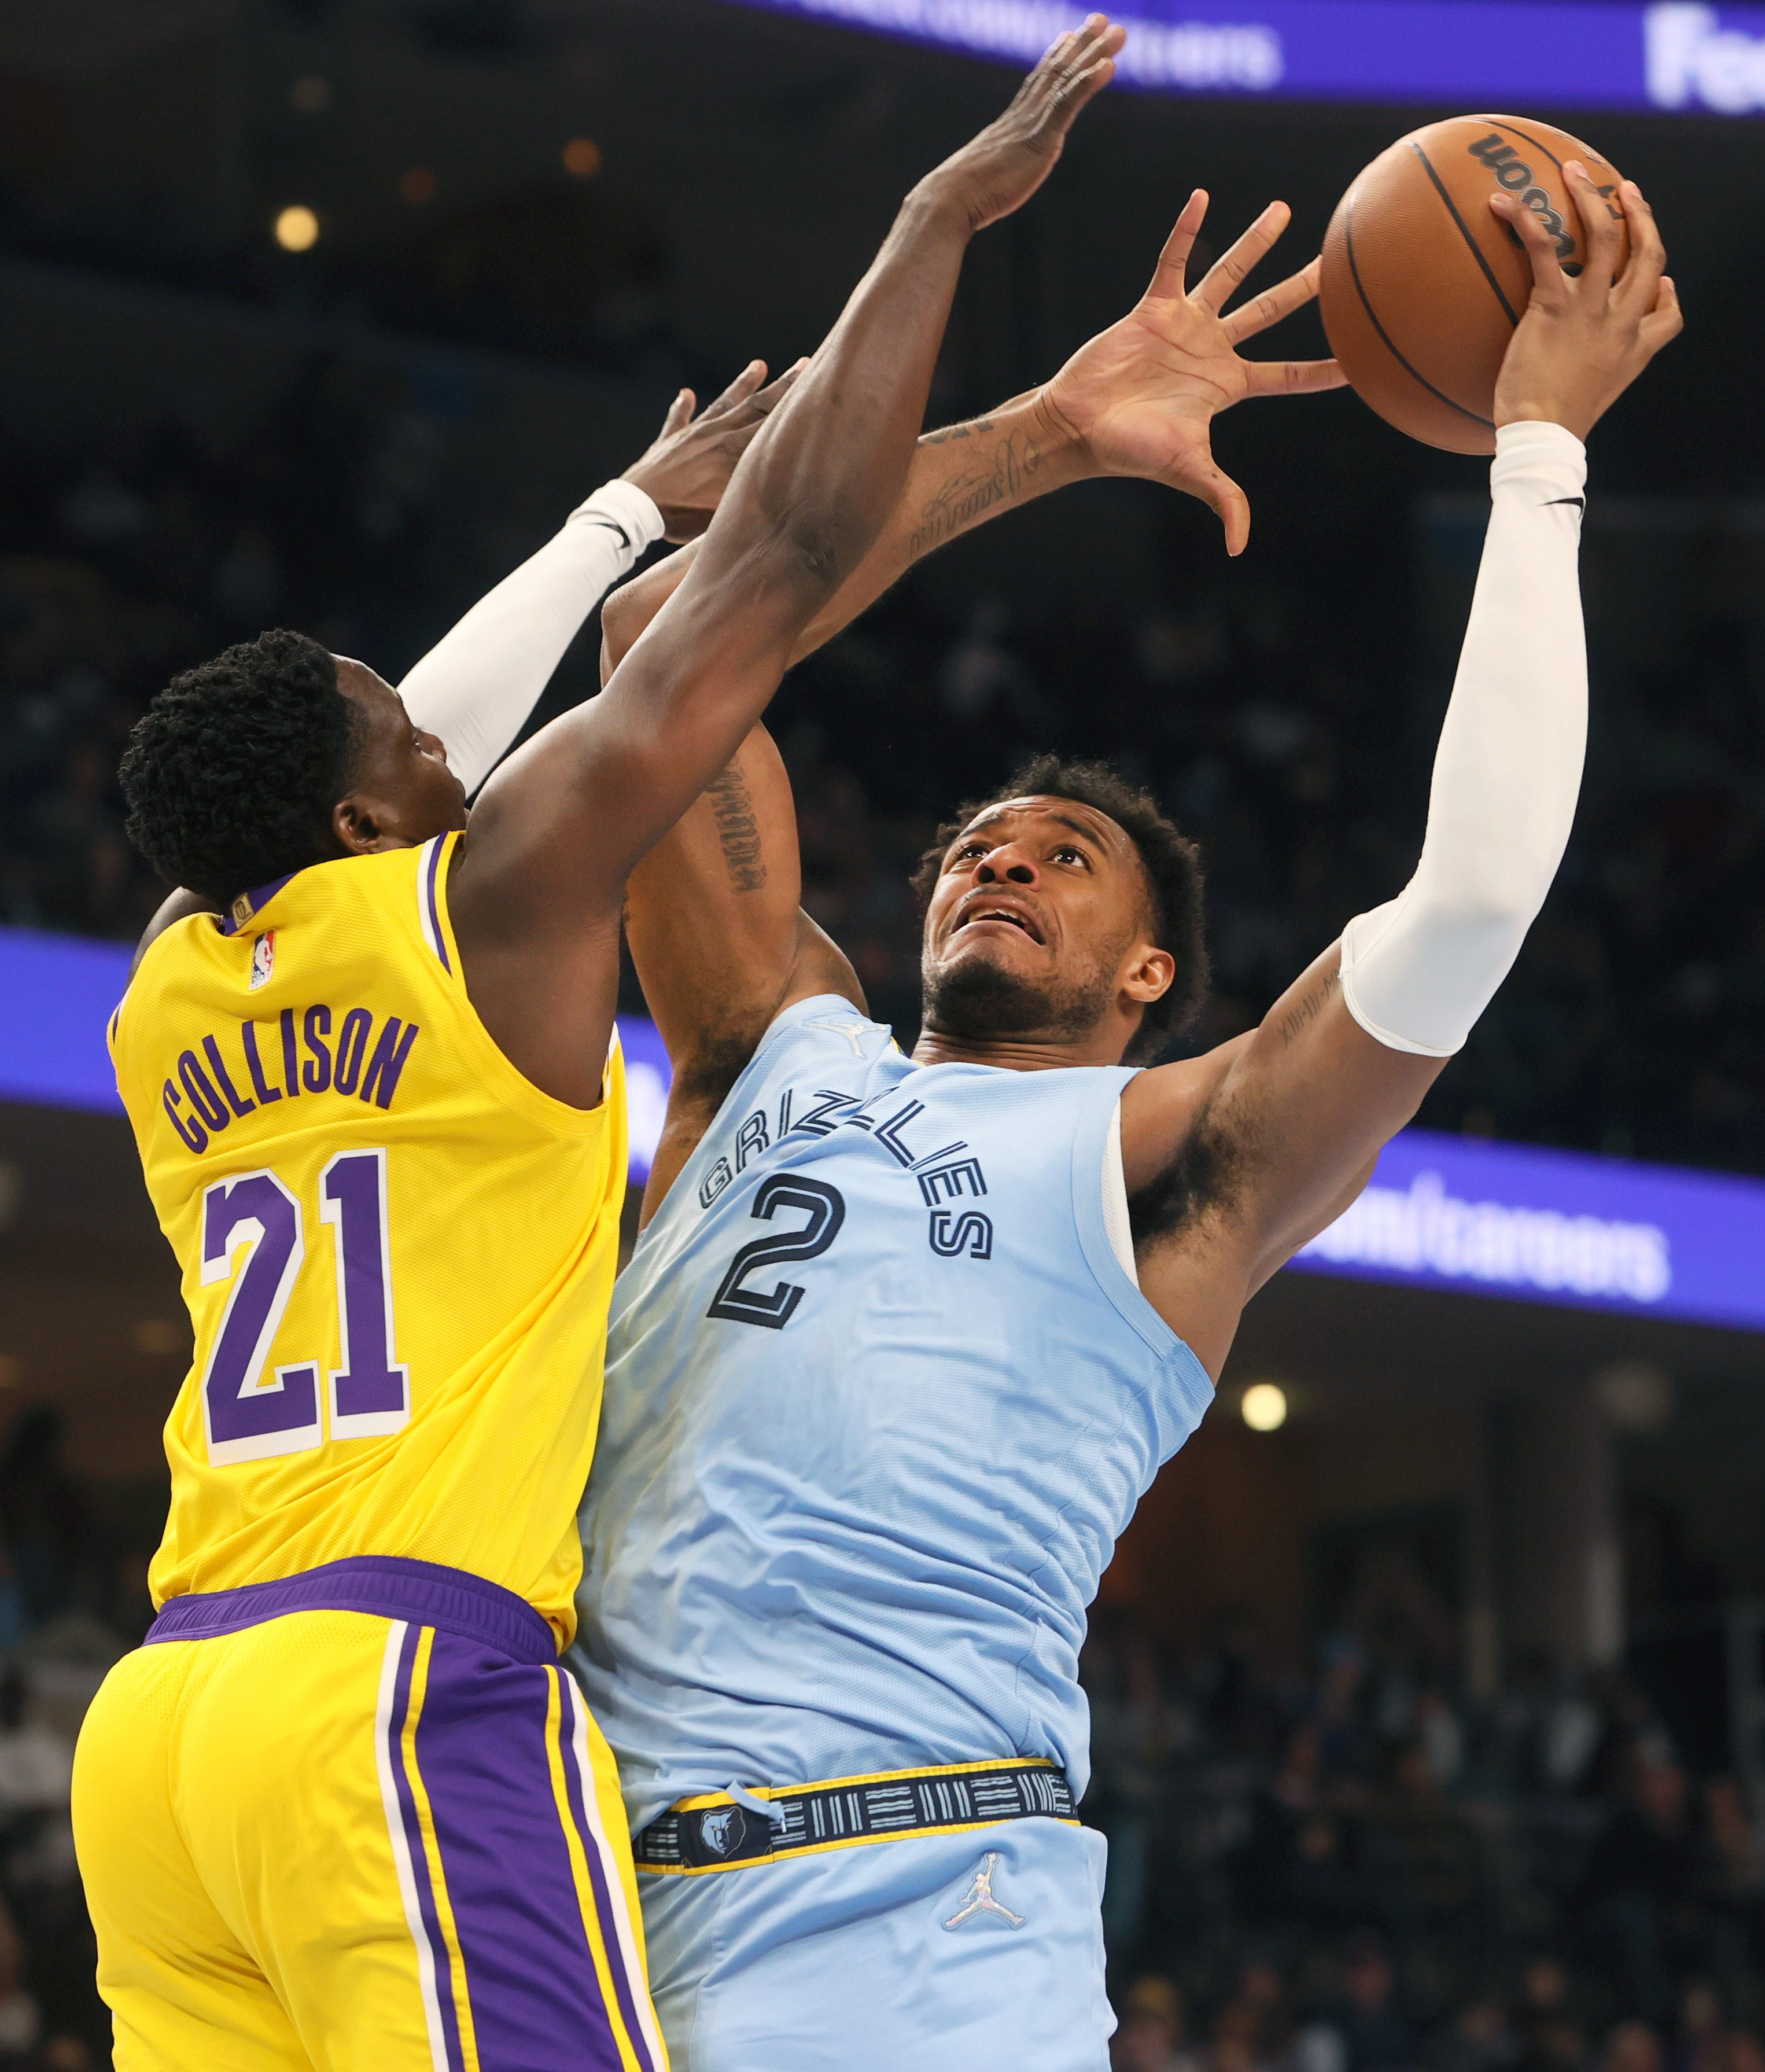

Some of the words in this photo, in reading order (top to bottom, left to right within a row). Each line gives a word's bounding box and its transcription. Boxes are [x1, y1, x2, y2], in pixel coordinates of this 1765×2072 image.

[163, 1004, 418, 1154] COLLISON
[200, 1147, 410, 1468] 21
[706, 1173, 846, 1330] 2
